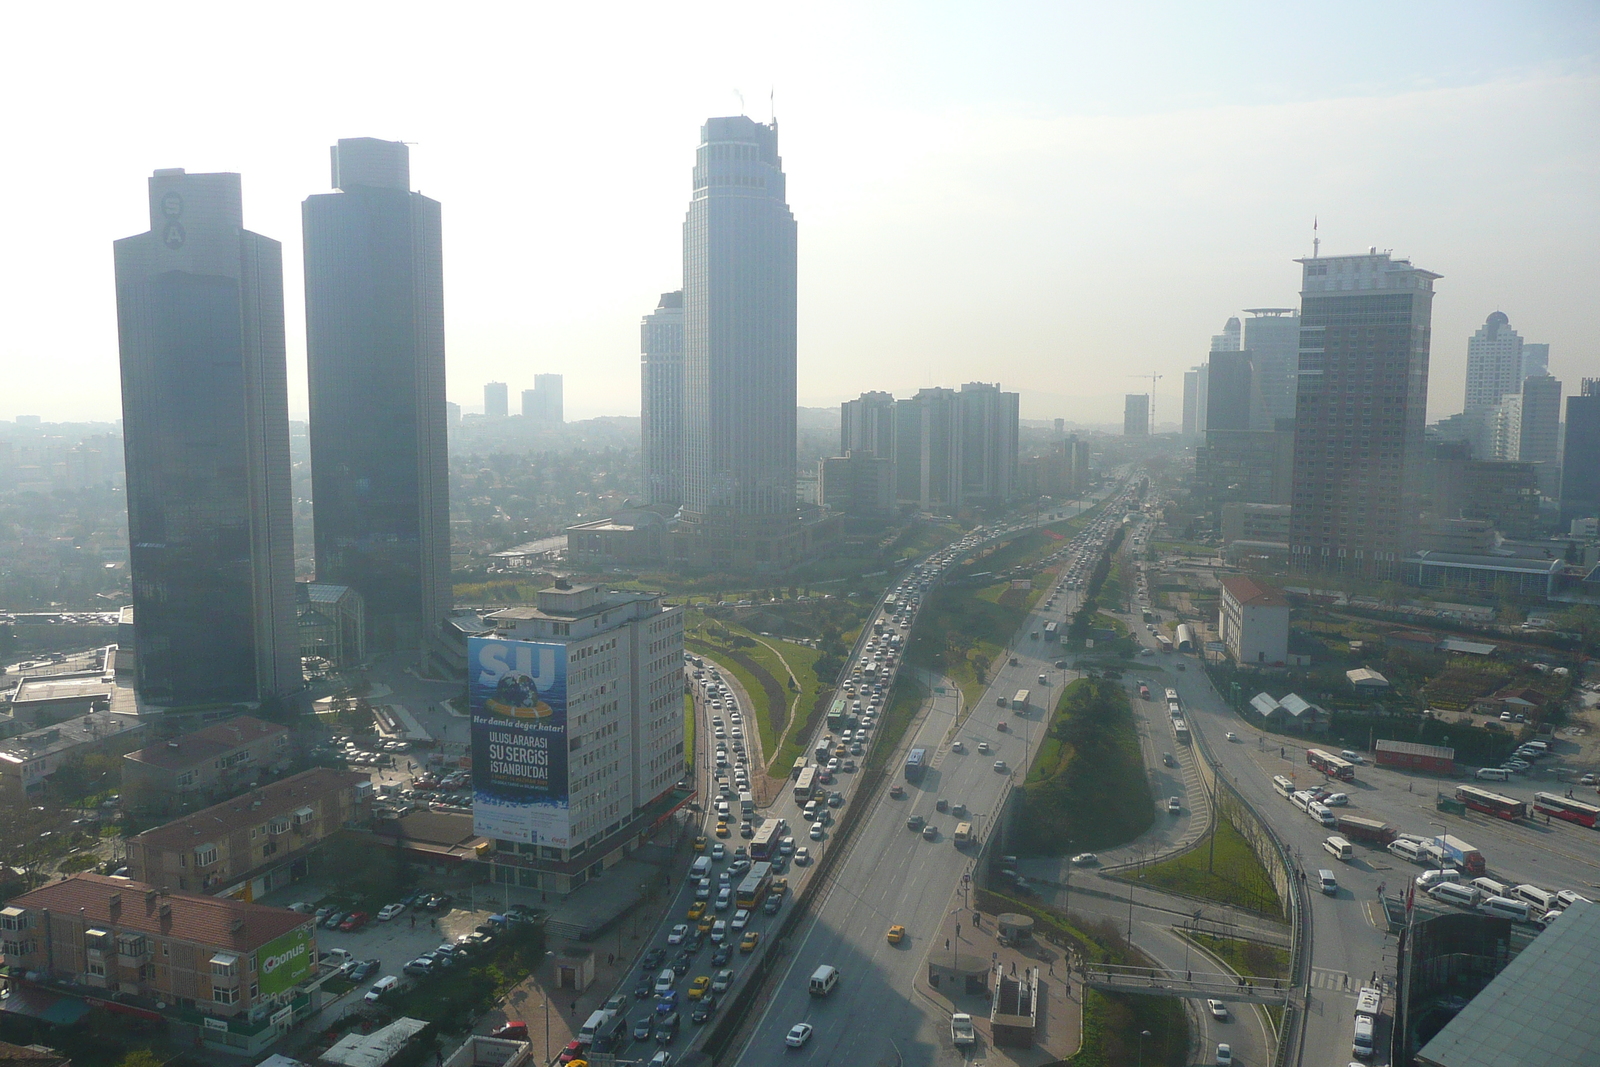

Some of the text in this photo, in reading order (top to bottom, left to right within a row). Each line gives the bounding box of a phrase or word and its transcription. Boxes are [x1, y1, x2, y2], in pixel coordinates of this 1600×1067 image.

[478, 644, 554, 691] SU
[474, 715, 564, 733] Her damla değer katar!
[489, 731, 548, 748] ULUSLARARASI
[489, 744, 504, 760] SU
[274, 943, 305, 968] bonus
